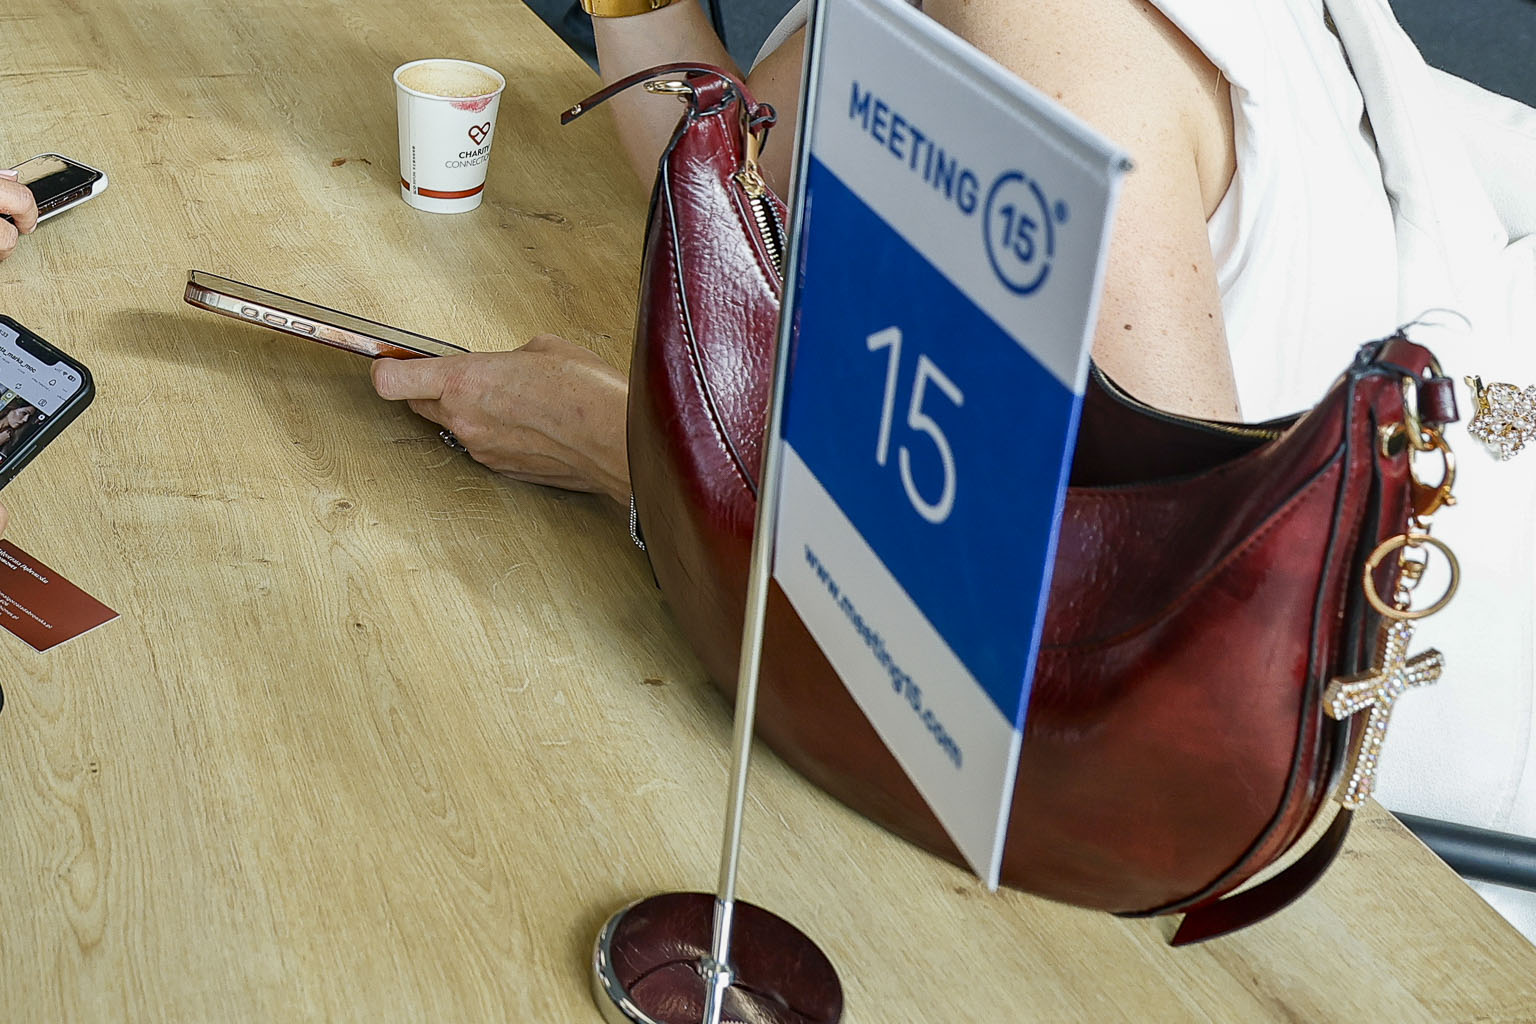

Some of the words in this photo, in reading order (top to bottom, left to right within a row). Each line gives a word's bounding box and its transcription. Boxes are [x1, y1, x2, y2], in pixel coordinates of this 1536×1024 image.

[445, 154, 490, 169] CONNECTIO
[848, 81, 980, 217] MEETING
[999, 203, 1038, 263] 15
[866, 326, 964, 524] 15
[804, 543, 963, 771] www.meeting15.com
